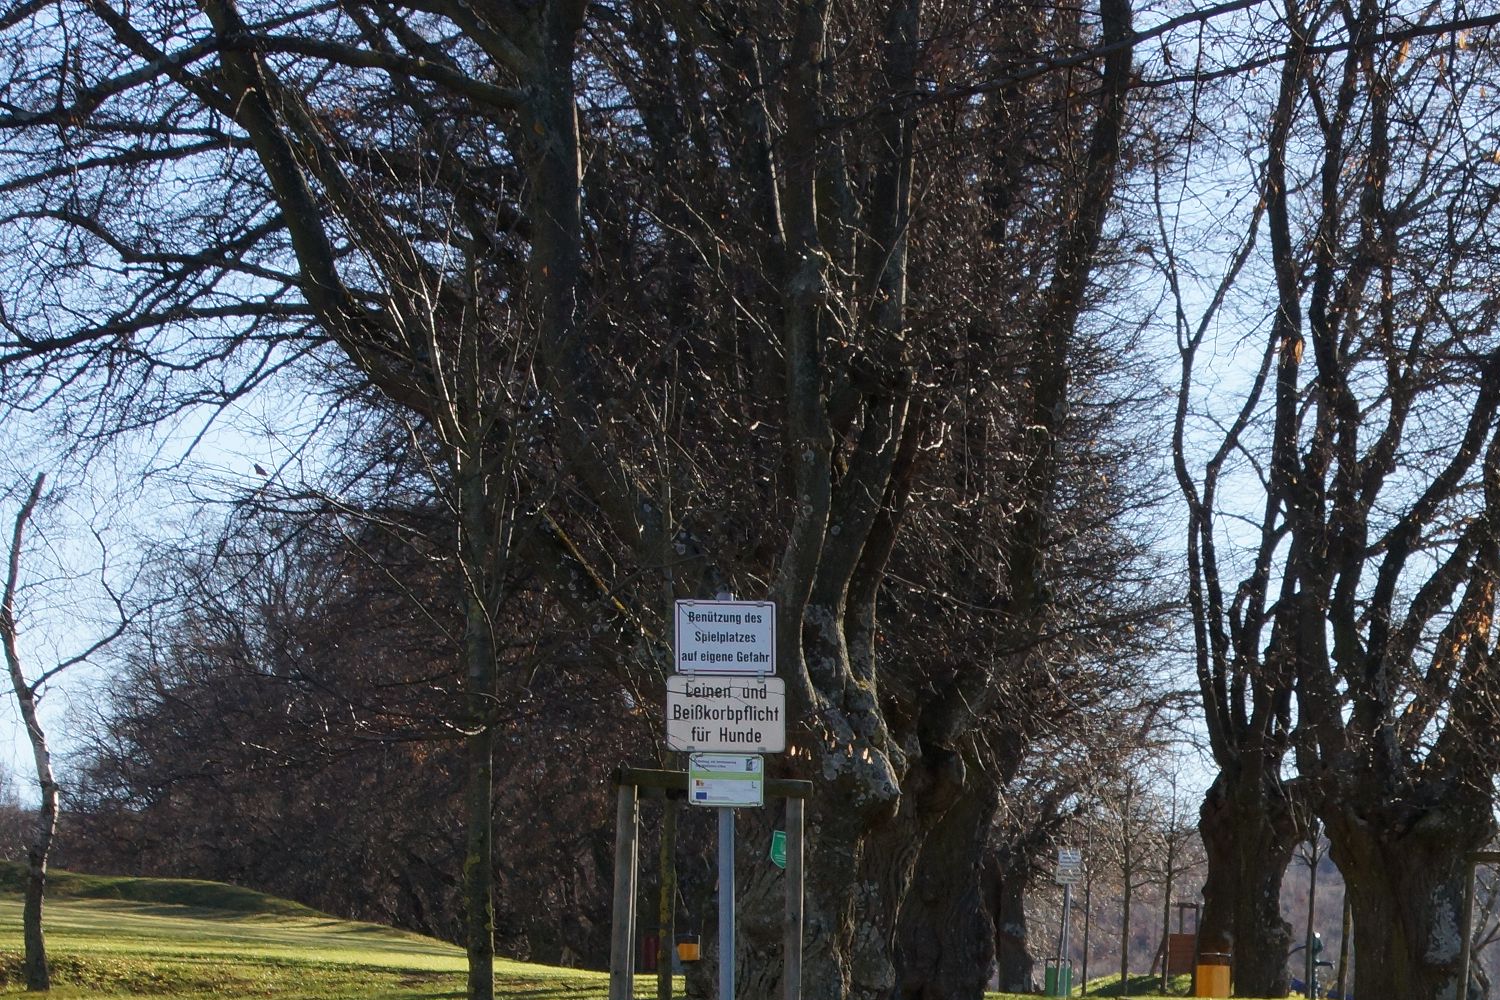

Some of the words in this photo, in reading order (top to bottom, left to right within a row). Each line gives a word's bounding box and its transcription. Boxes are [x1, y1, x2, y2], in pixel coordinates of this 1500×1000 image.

[689, 611, 741, 624] Benützung
[745, 612, 762, 623] des
[695, 631, 756, 644] Spielplatzes
[682, 651, 697, 661] auf
[701, 651, 733, 663] eigene
[737, 652, 769, 662] Gefahr
[686, 683, 731, 698] Leinen
[743, 684, 766, 699] und
[673, 704, 779, 724] Beißkorbpflicht
[692, 727, 711, 742] für
[720, 727, 761, 742] Hunde
